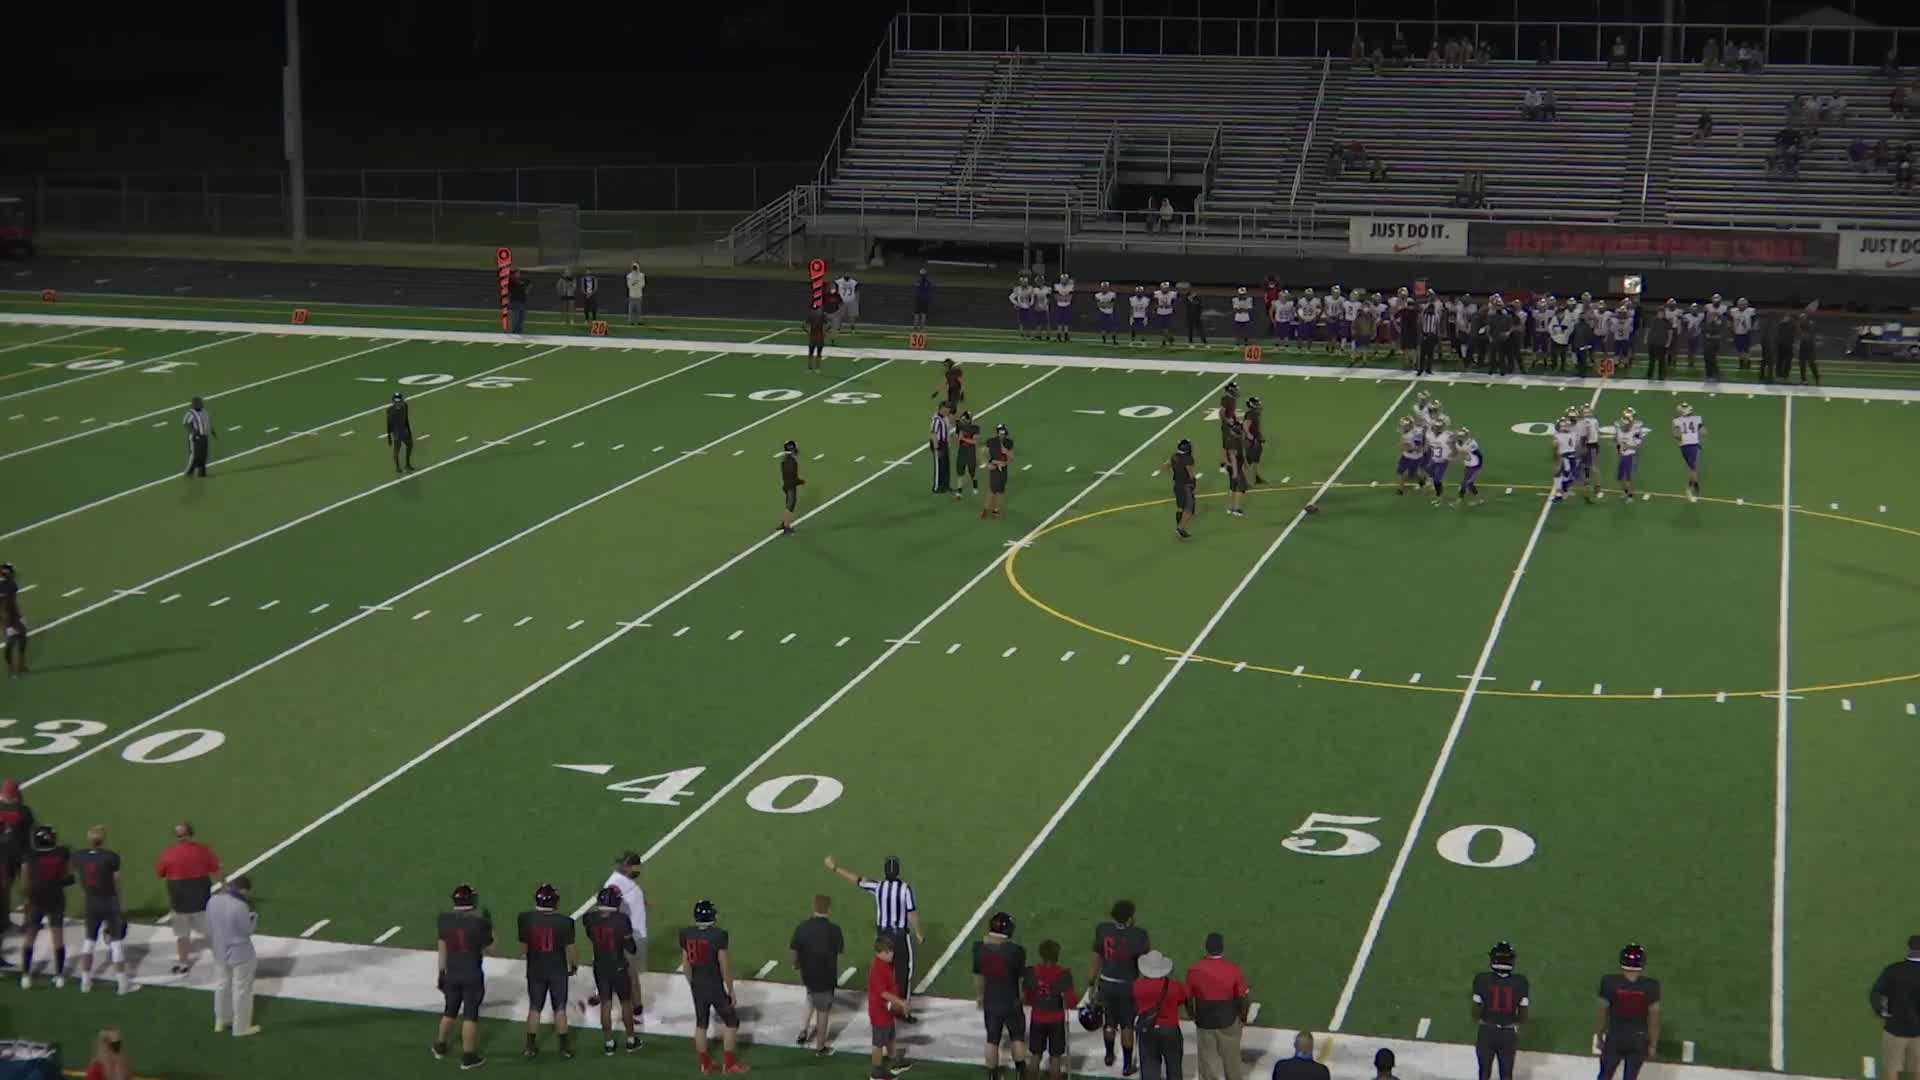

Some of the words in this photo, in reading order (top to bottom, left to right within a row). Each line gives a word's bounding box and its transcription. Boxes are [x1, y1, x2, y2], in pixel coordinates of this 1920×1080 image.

[1369, 222, 1405, 238] JUST
[1407, 223, 1429, 239] DO
[1859, 237, 1896, 253] JUST
[1246, 347, 1259, 359] 40
[1682, 421, 1696, 434] 14
[1490, 986, 1514, 1011] 11
